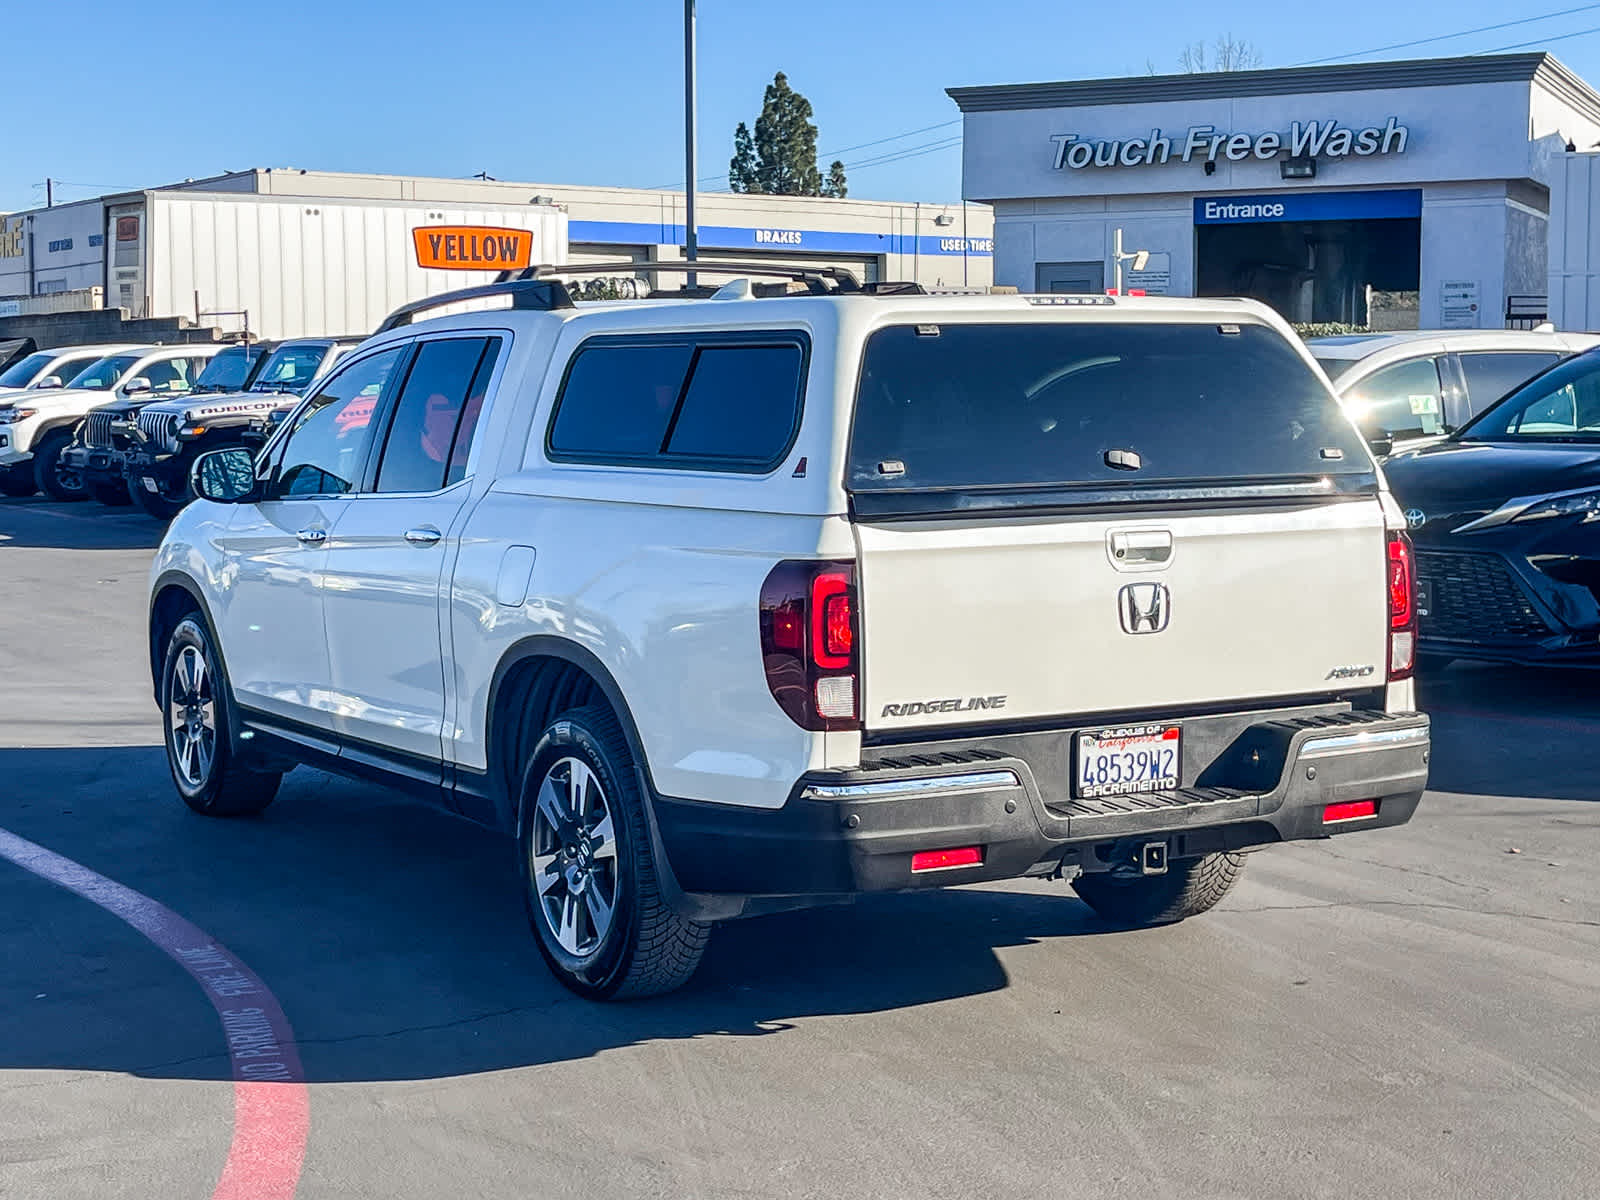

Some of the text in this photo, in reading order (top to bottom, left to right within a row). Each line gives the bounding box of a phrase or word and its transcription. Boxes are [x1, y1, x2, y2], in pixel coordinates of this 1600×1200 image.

[1049, 116, 1409, 170] Touch Free Wash
[1204, 201, 1285, 219] Entrance
[754, 229, 802, 245] BRAKES
[940, 238, 968, 252] USED
[428, 233, 519, 263] YELLOW
[200, 402, 279, 415] RUBICON
[880, 694, 1008, 718] RIDGELINE
[1146, 724, 1163, 735] OF
[1083, 748, 1174, 786] 48539W2
[1082, 777, 1177, 798] SACRAMENTO
[175, 944, 292, 1081] NO PARKING FIRE LANE
